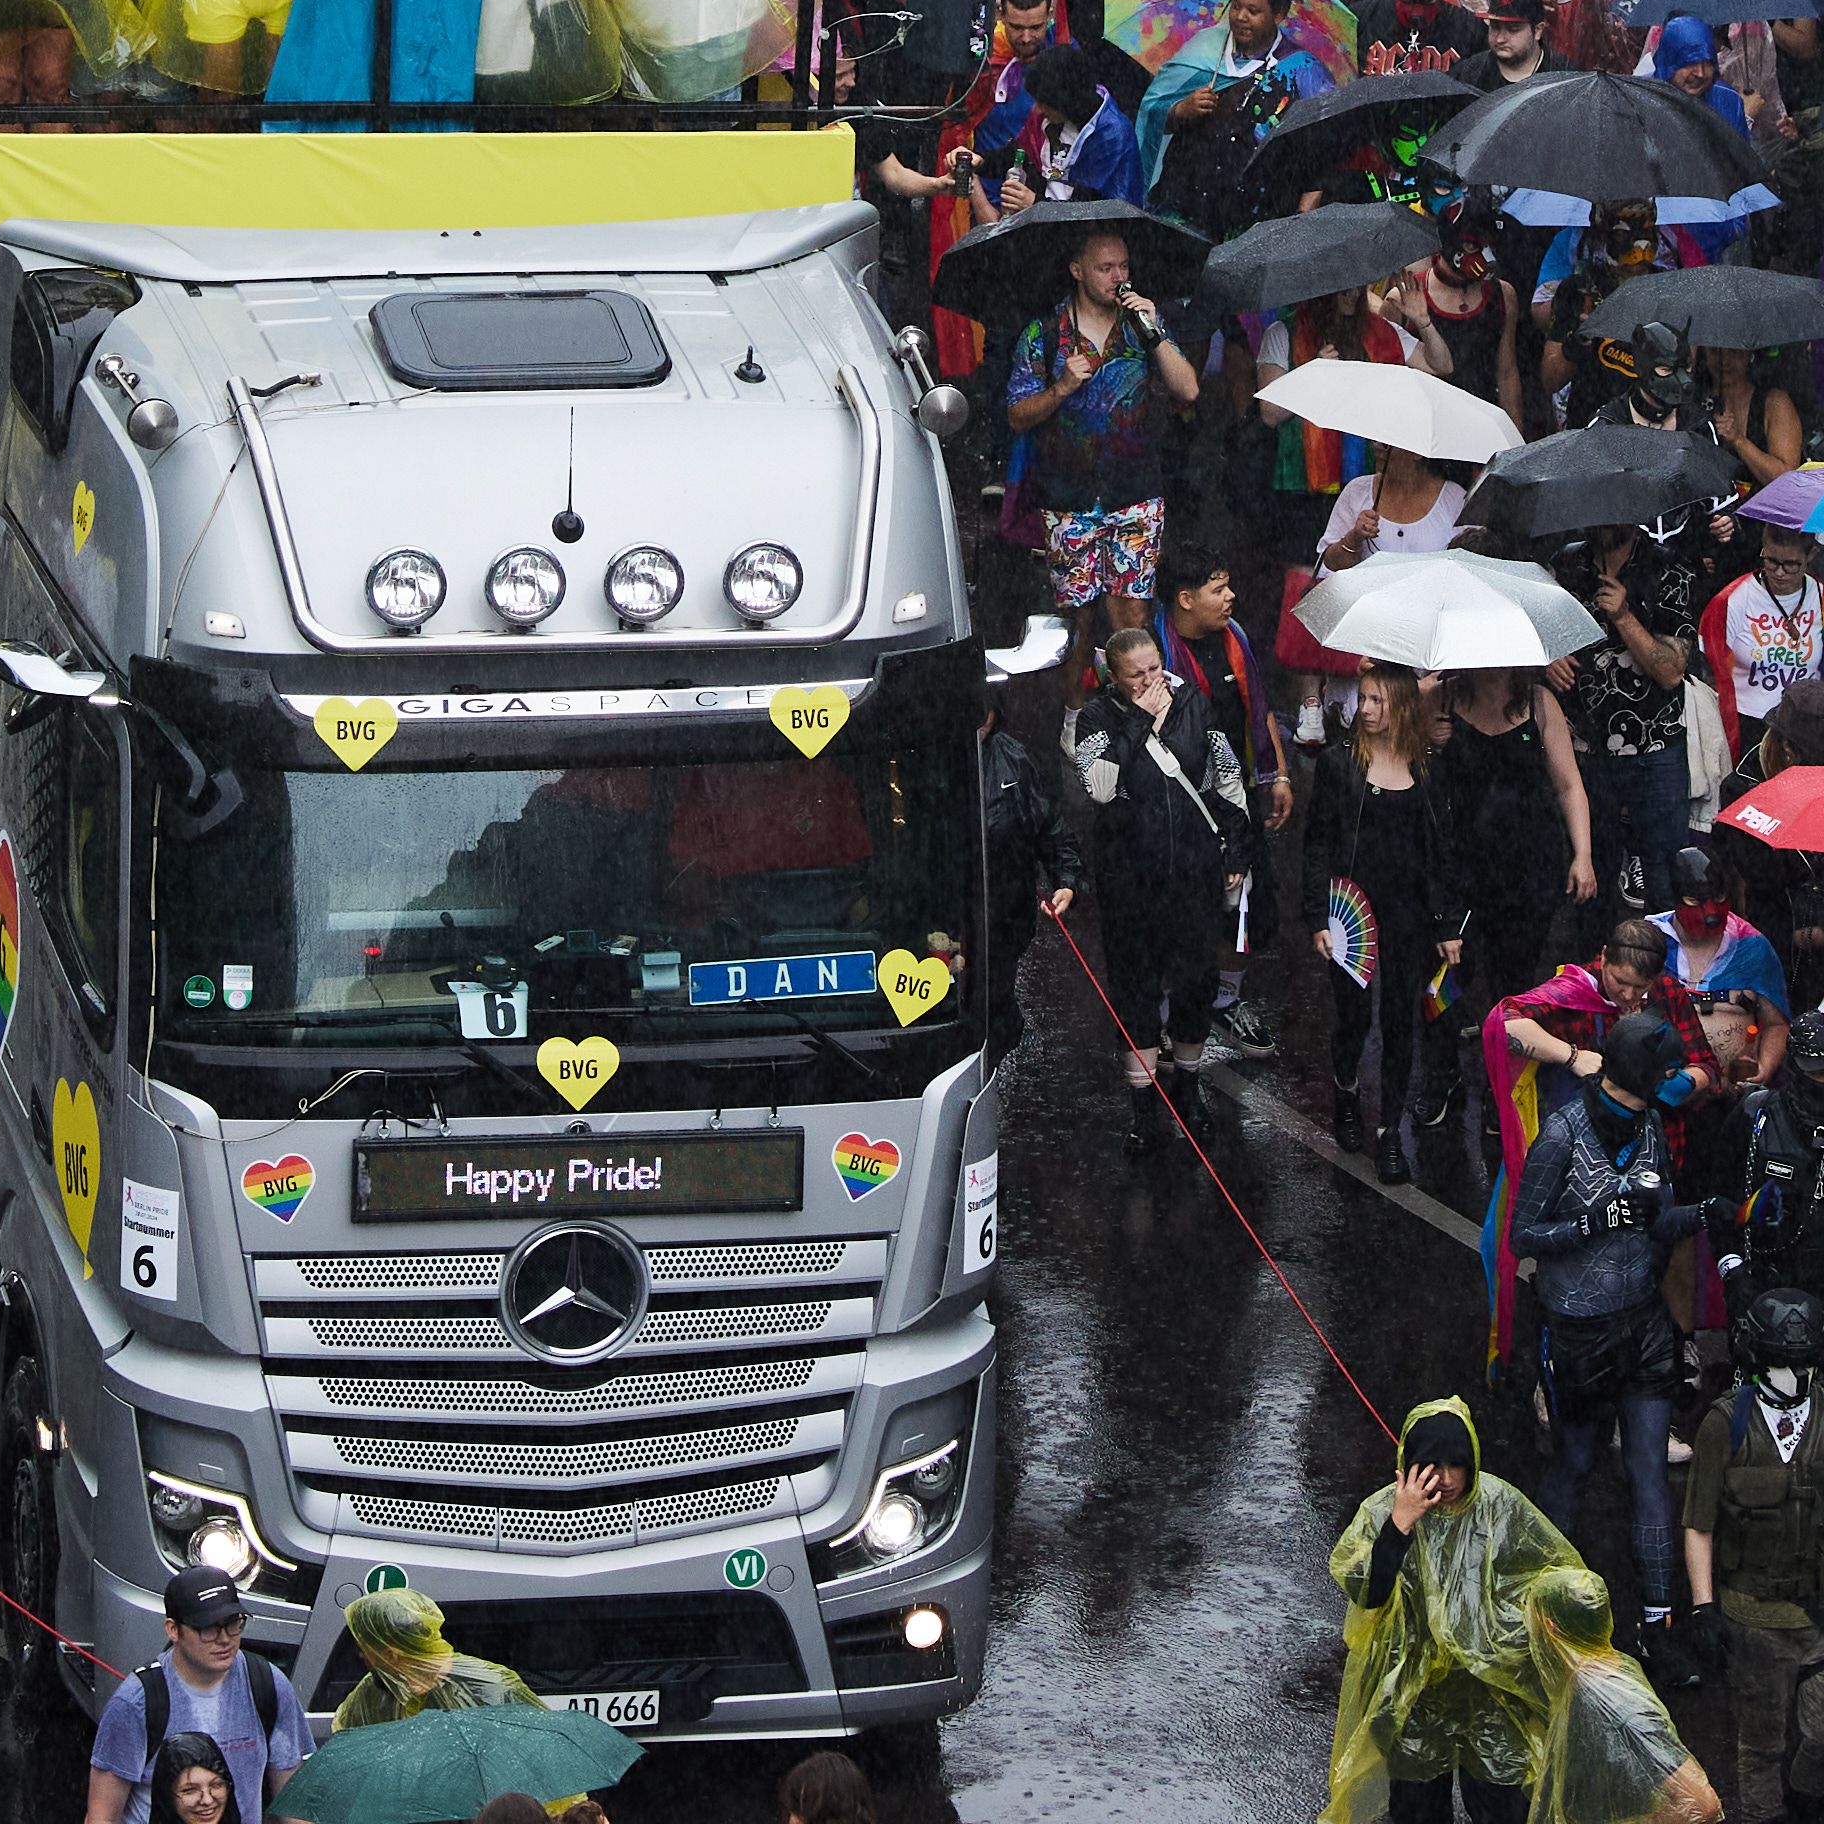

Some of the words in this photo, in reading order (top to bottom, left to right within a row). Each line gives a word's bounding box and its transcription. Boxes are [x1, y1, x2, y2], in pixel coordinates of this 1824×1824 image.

[1751, 609, 1814, 643] every
[1766, 646, 1806, 670] FREE
[336, 720, 376, 741] BVG
[791, 708, 829, 729] BVG
[894, 973, 932, 1000] BVG
[483, 992, 518, 1037] 6
[559, 1059, 598, 1080] BVG
[64, 1140, 88, 1199] BVG
[446, 1162, 556, 1200] Happy
[568, 1155, 662, 1194] Pride!
[848, 1153, 883, 1176] BVG
[263, 1174, 298, 1198] BVG
[979, 1214, 994, 1258] 6
[132, 1244, 157, 1288] 6
[731, 1553, 760, 1580] VI
[606, 1695, 656, 1723] 666
